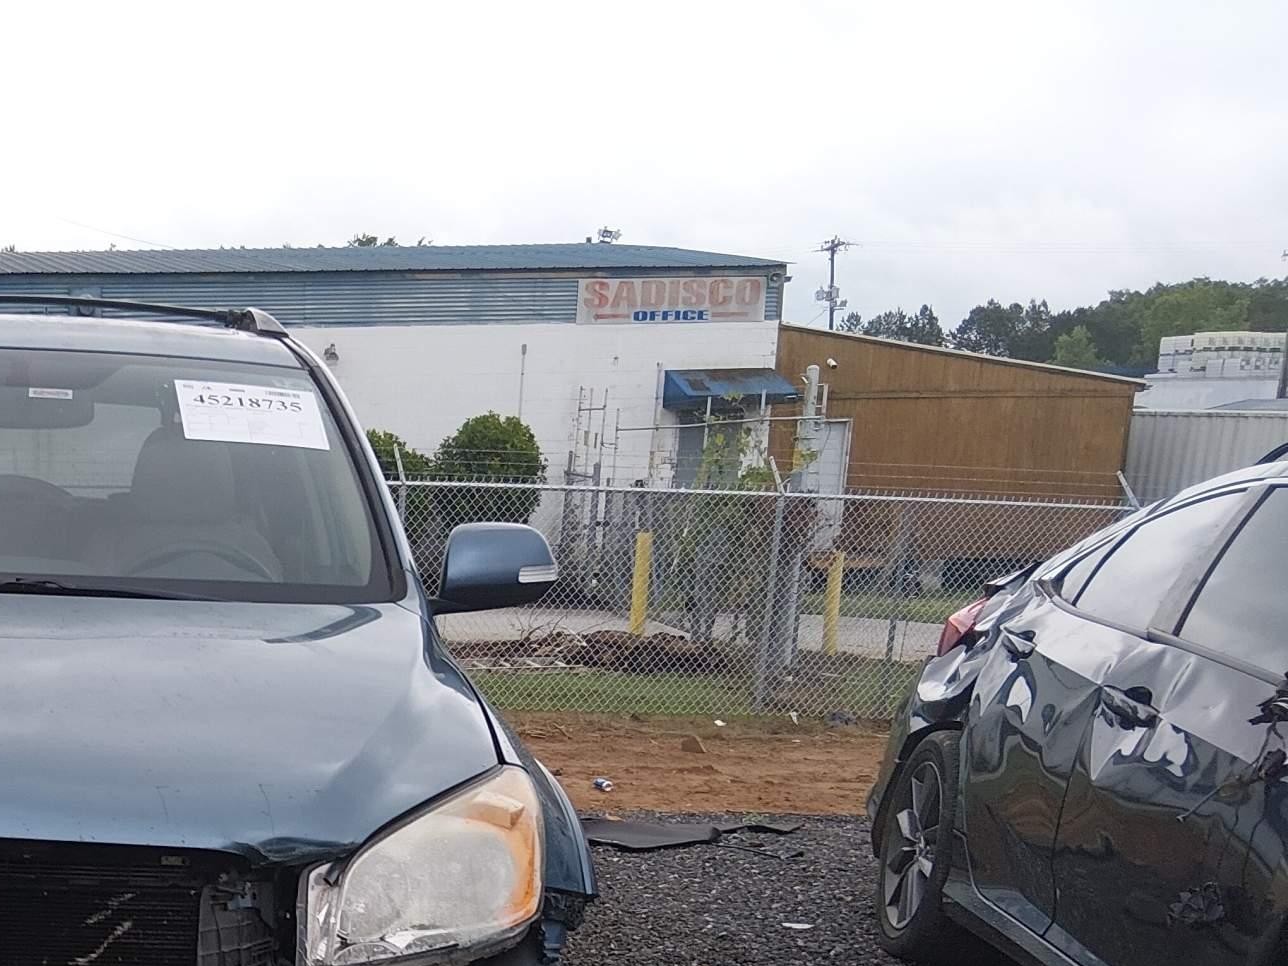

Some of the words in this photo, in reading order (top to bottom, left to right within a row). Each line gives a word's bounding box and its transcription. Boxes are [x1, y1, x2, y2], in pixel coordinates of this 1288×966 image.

[583, 278, 761, 309] SADISCO
[632, 309, 709, 322] OFFICE
[193, 394, 303, 413] 45218735
